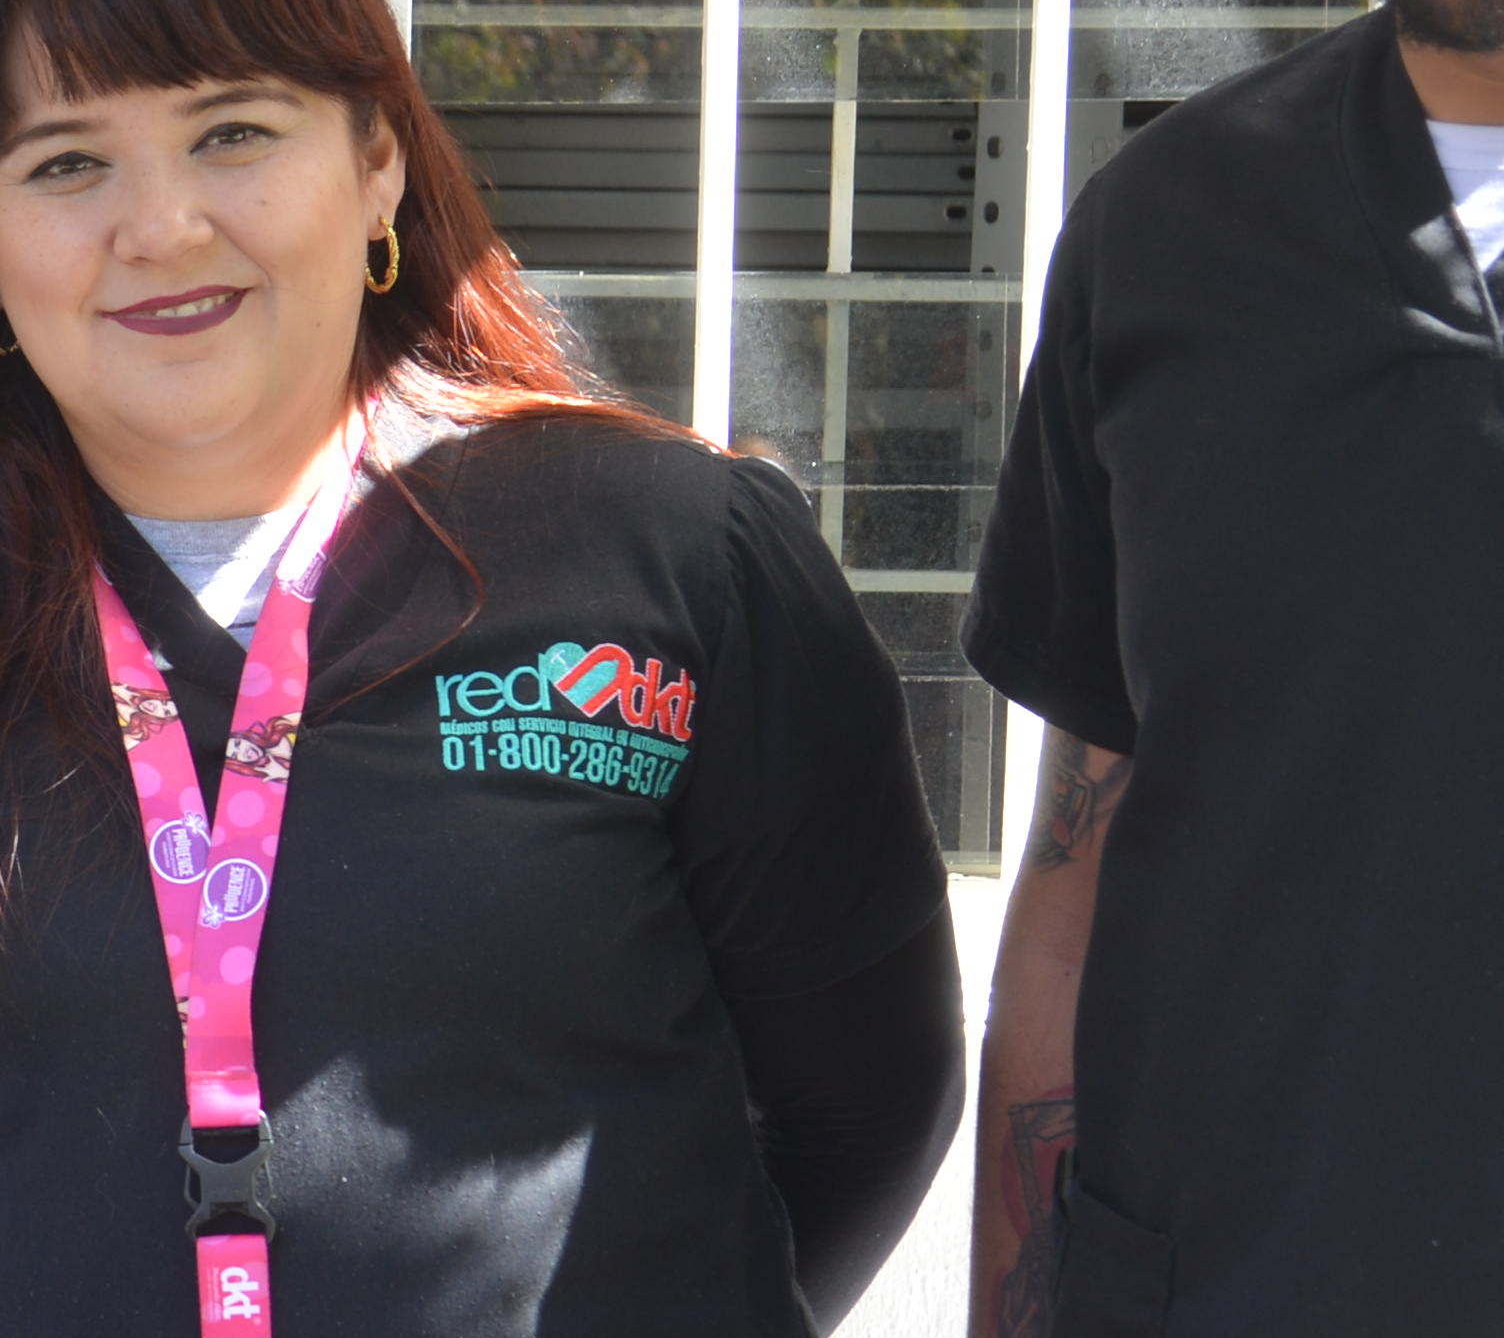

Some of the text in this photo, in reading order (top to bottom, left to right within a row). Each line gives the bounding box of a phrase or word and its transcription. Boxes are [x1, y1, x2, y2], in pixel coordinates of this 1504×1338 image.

[435, 653, 551, 717] red
[518, 717, 567, 735] SERVICIO
[568, 720, 614, 742] INTEGRAL
[442, 732, 681, 799] 01-800-286-9314
